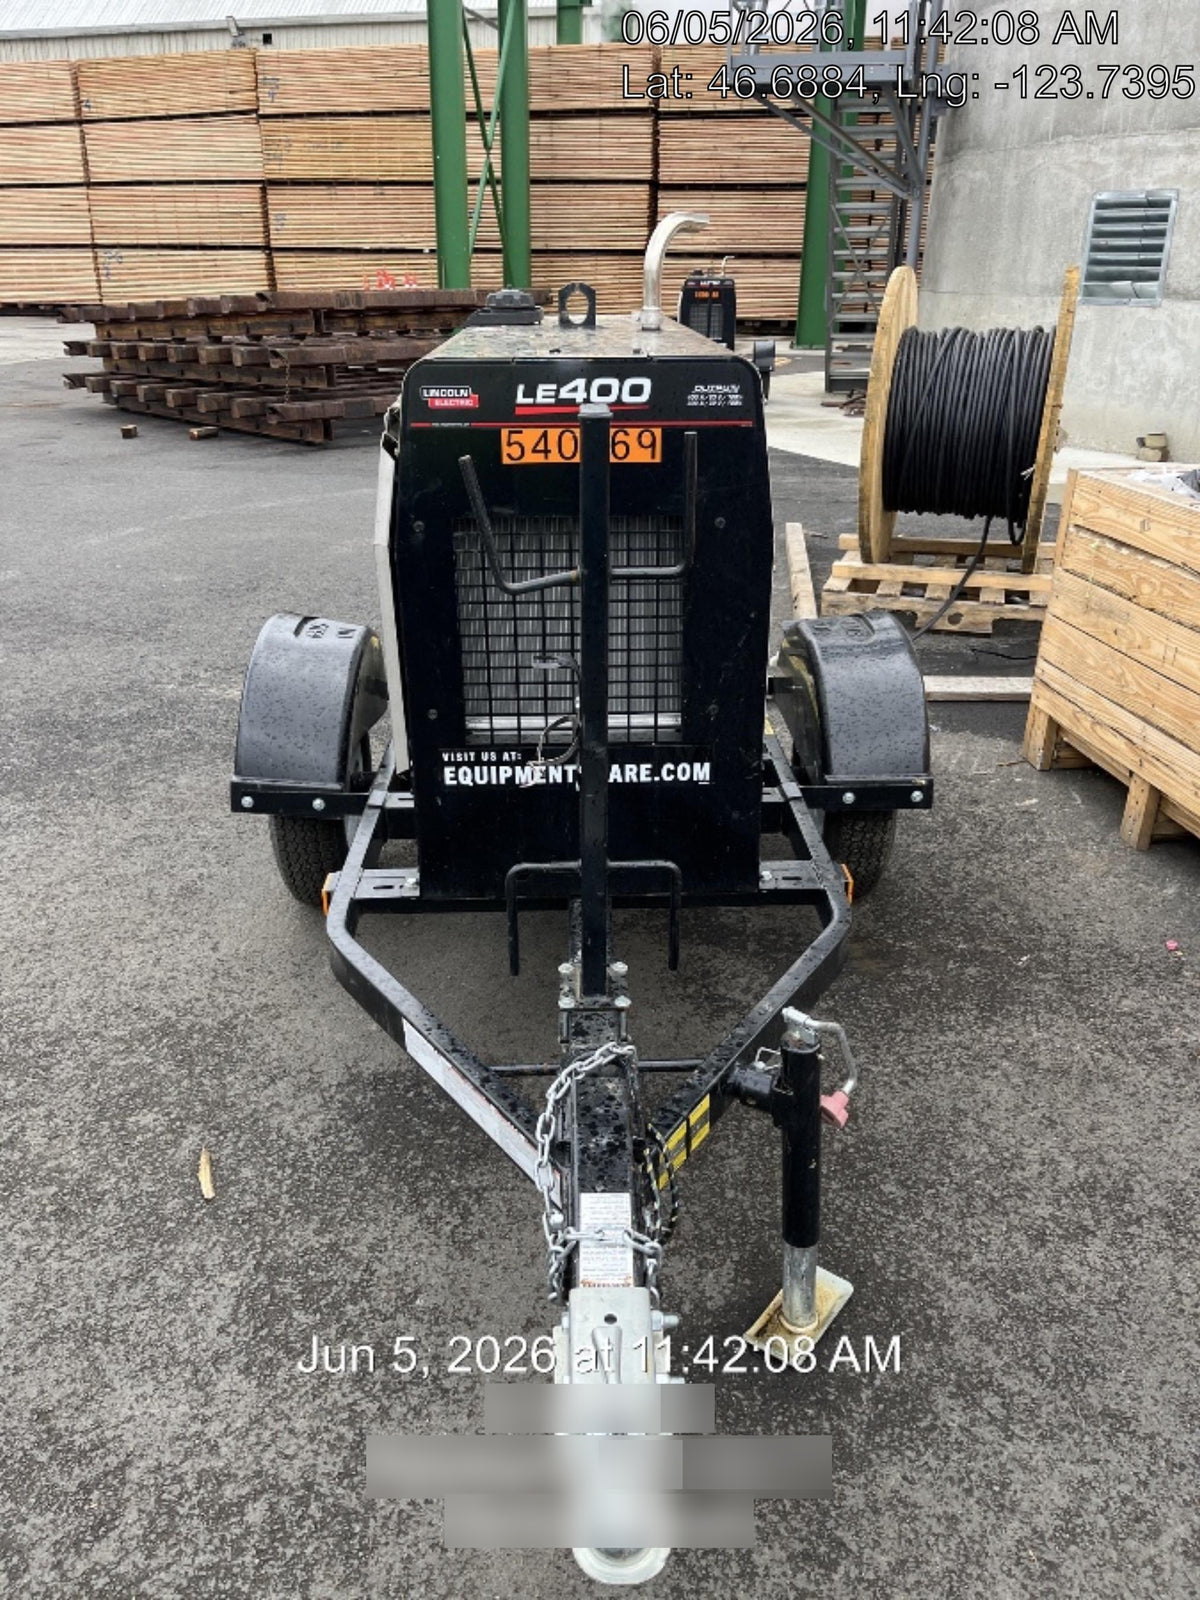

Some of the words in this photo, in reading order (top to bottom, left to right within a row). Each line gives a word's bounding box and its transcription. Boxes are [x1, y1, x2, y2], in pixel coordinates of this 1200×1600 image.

[422, 388, 469, 397] LINCOLN
[515, 376, 652, 404] LE400
[434, 399, 474, 407] ELECTRIC
[506, 428, 657, 461] 54069
[442, 751, 475, 762] VISIT
[481, 751, 497, 762] US
[502, 751, 522, 762] AT:
[443, 762, 711, 787] EQUIPMENTARE.COM
